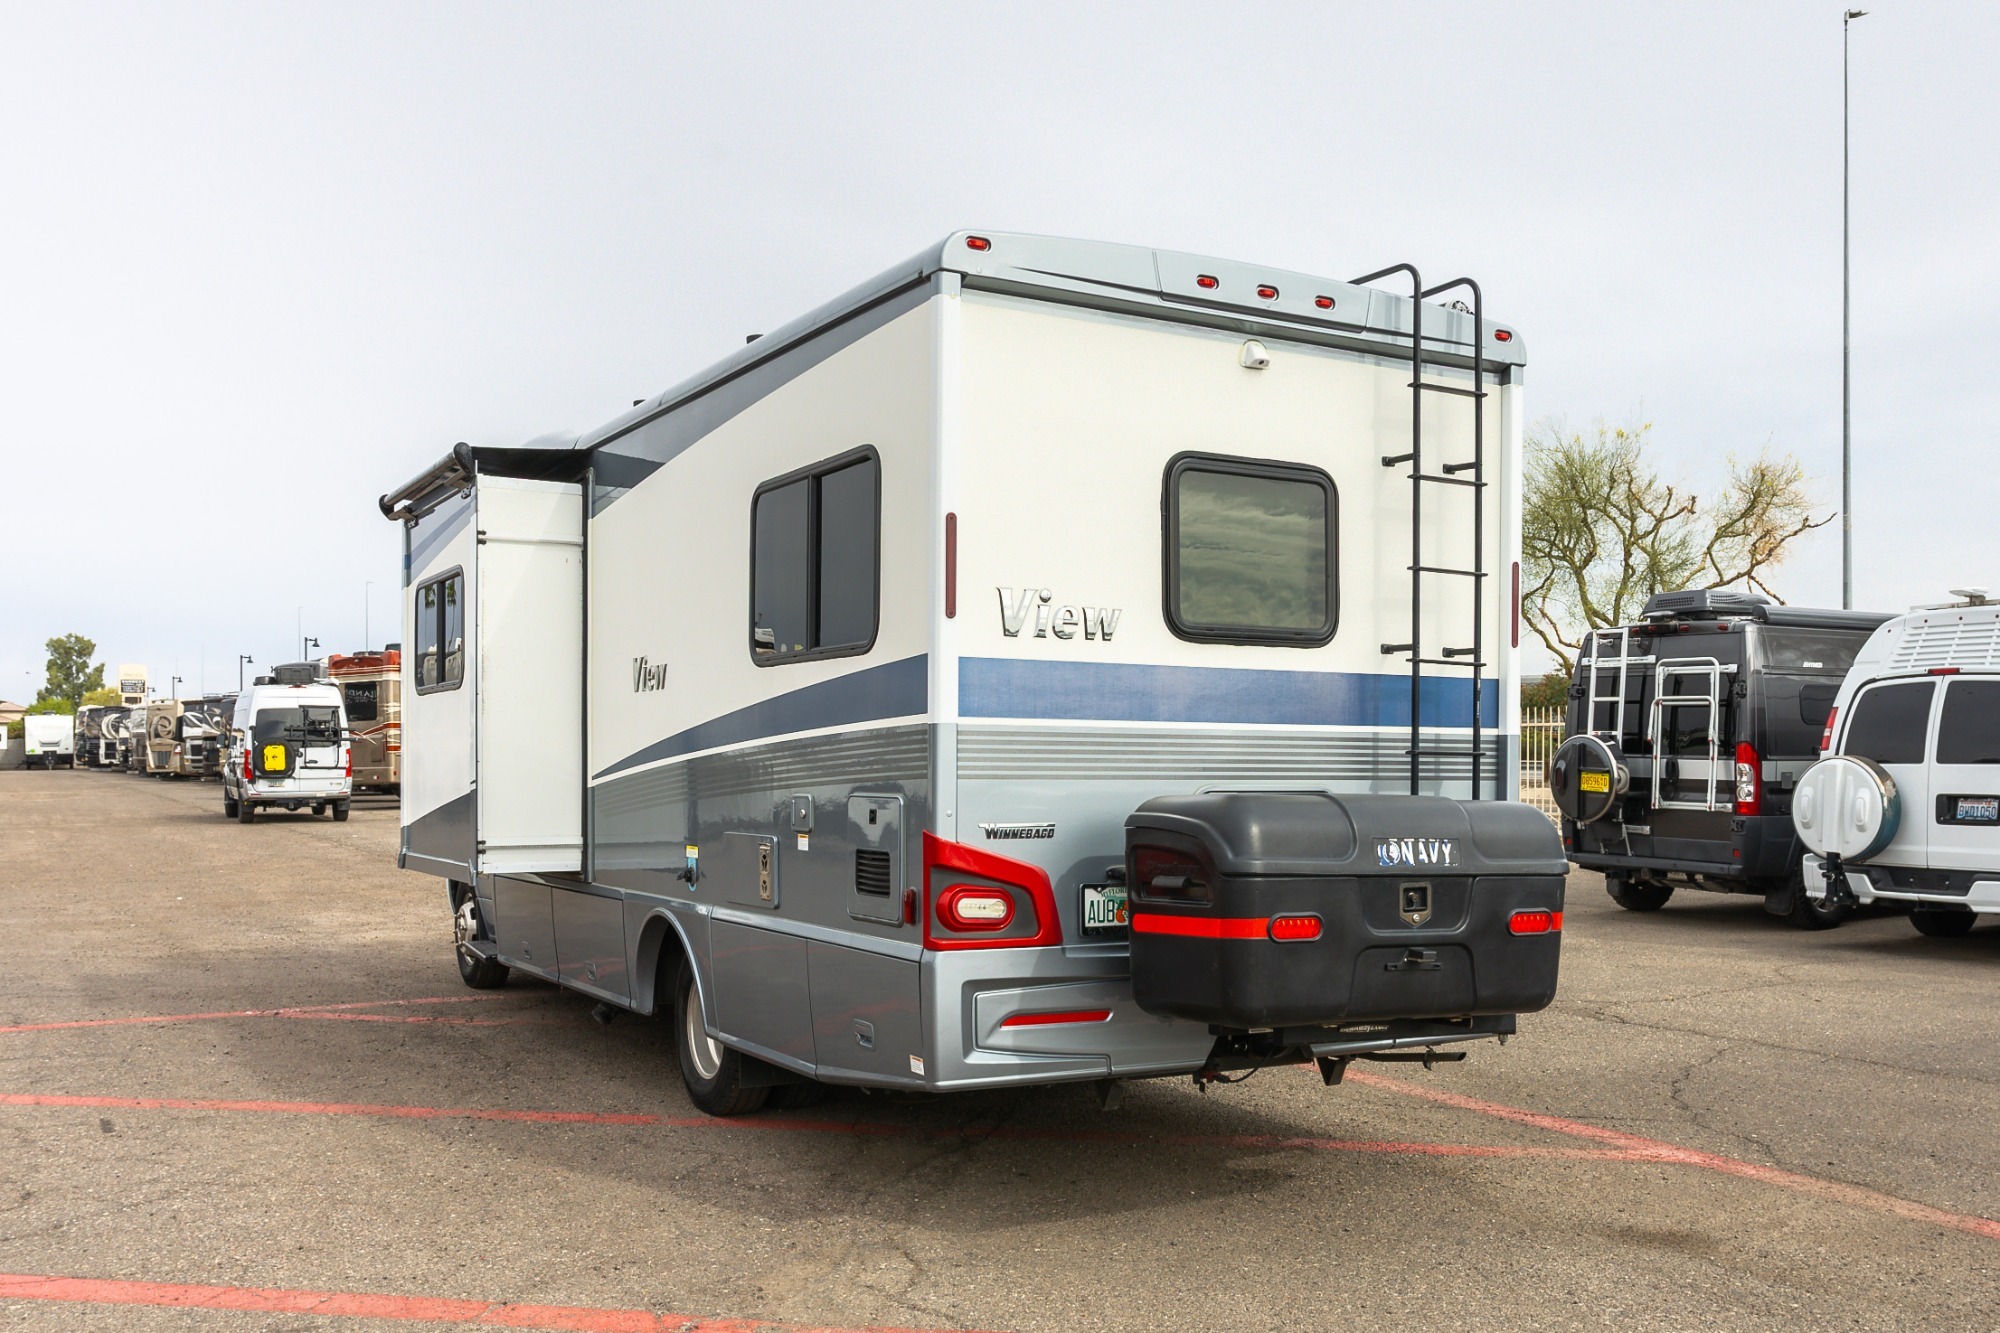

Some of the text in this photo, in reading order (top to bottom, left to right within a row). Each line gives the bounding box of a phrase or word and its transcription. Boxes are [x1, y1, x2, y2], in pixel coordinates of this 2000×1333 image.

[995, 586, 1123, 642] View
[632, 654, 668, 693] View
[978, 822, 1056, 840] WINNEBAGO
